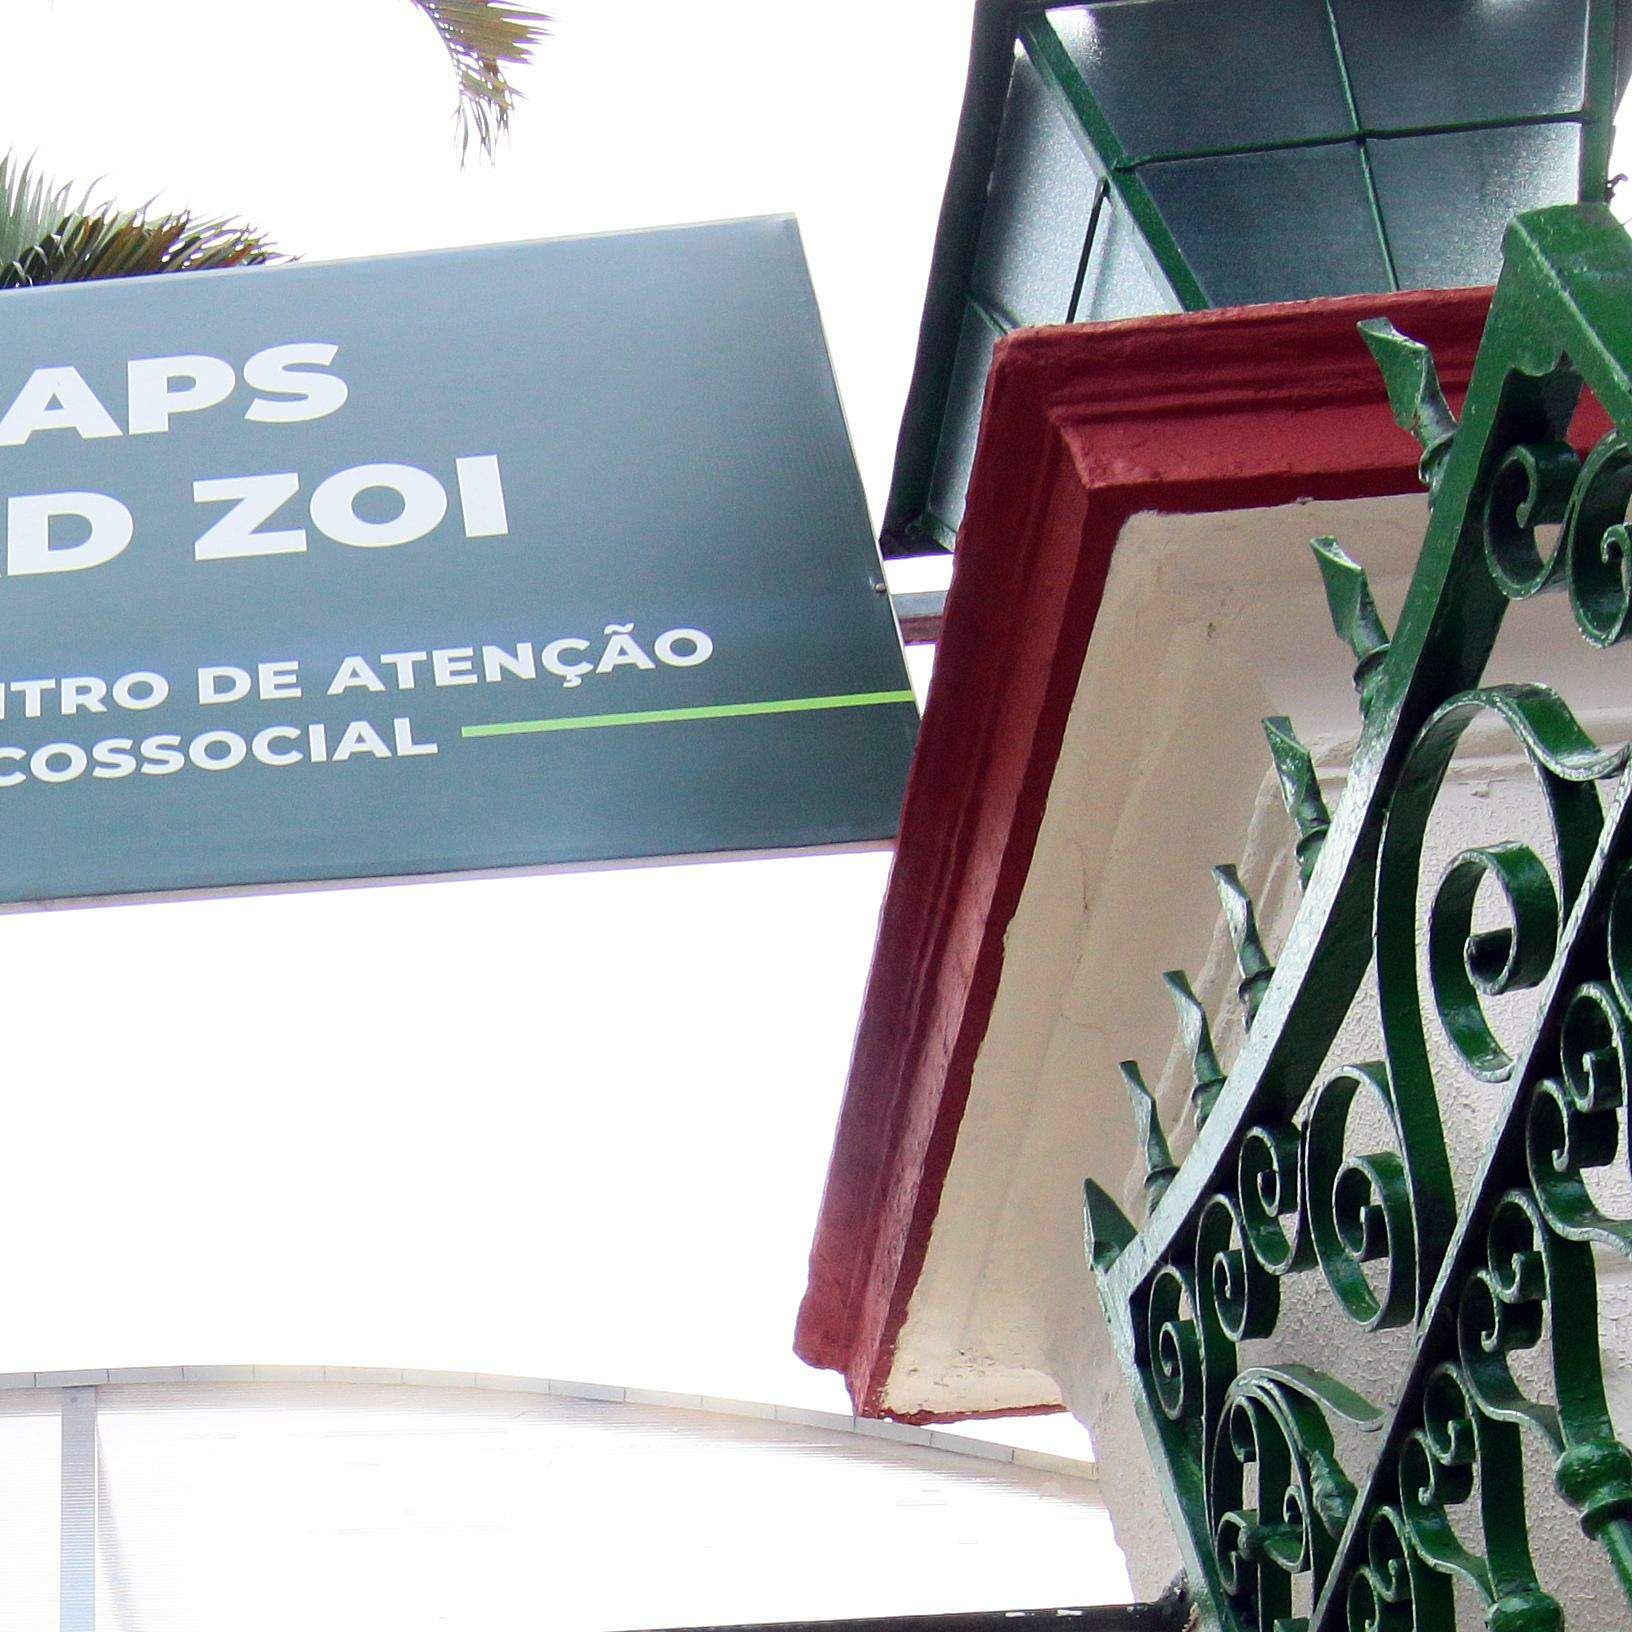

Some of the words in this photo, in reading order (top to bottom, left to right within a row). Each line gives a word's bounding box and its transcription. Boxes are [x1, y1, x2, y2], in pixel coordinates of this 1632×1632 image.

[192, 455, 509, 562] ZOI
[198, 660, 301, 705] DE
[329, 623, 714, 693] ATENÇÃO
